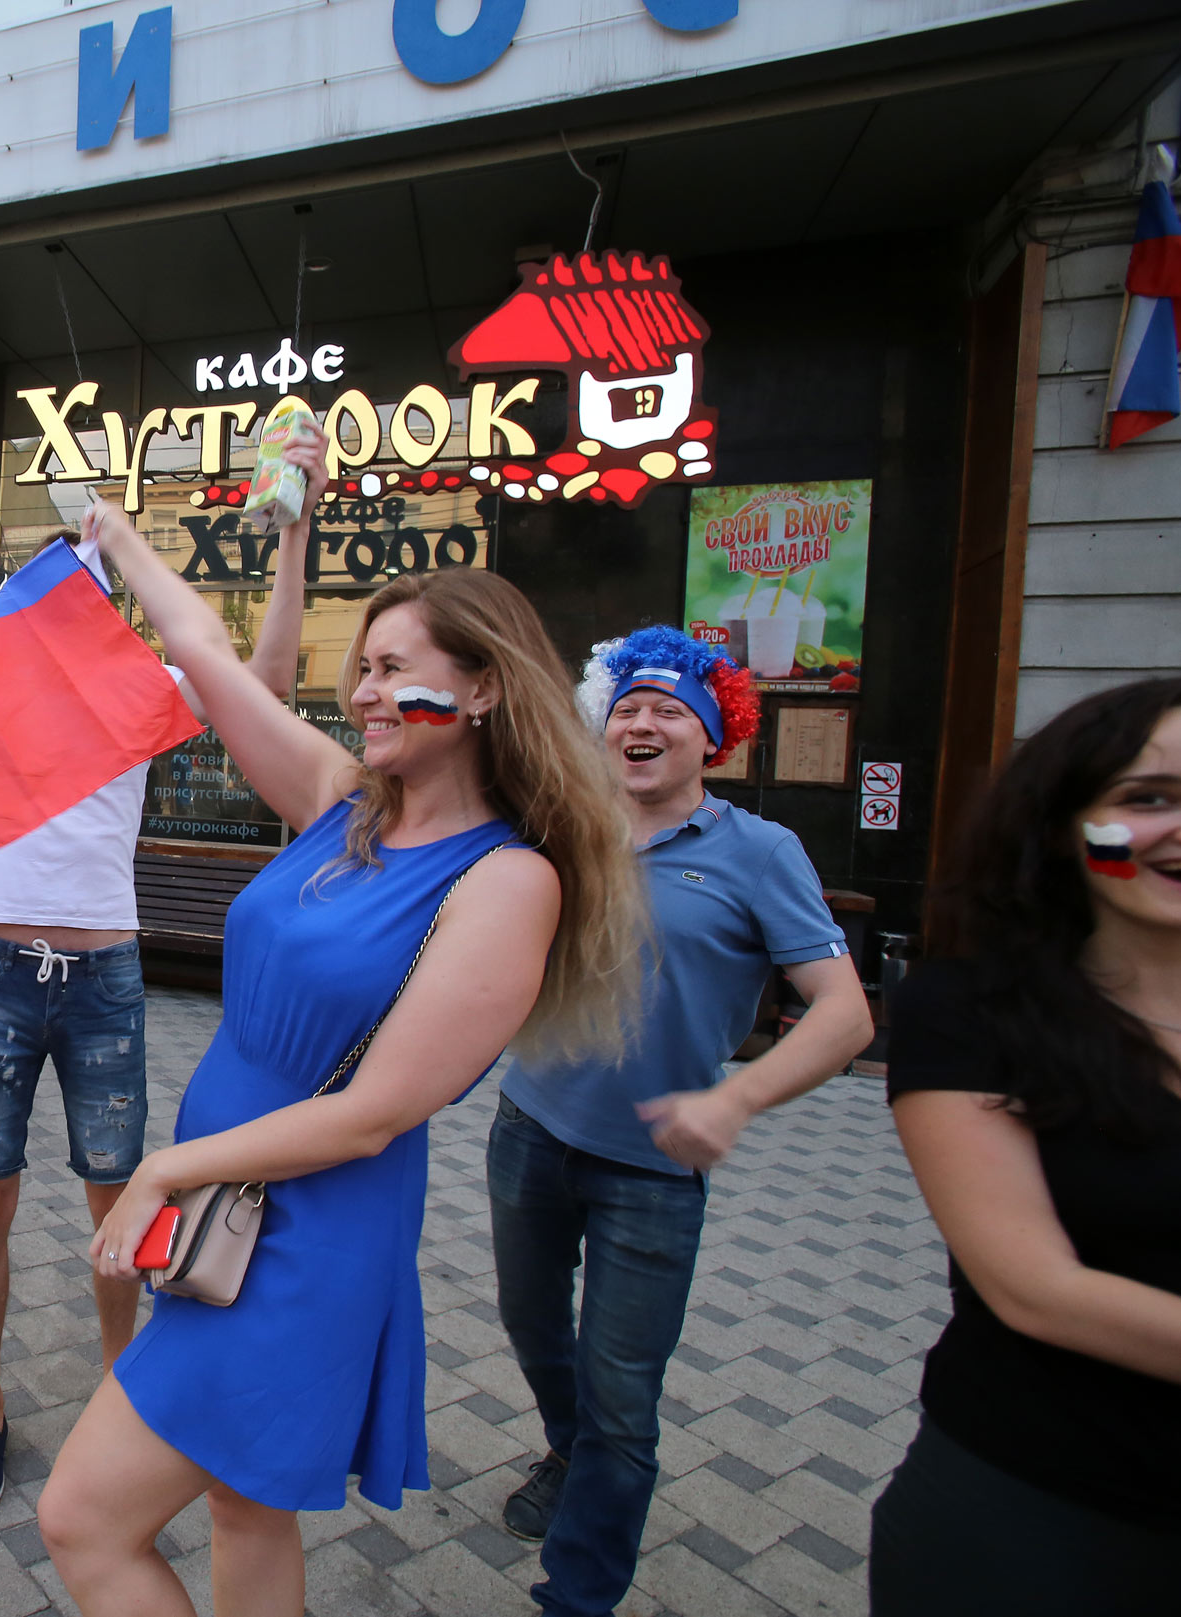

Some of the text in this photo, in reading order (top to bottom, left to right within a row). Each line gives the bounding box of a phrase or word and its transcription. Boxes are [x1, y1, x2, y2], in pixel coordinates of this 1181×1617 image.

[76, 5, 173, 152] И
[195, 337, 345, 395] кафе
[705, 500, 851, 550] СВОЙ ВКУС
[728, 536, 831, 573] ПРОХЛАДЫ
[154, 786, 255, 802] присутствии!
[173, 771, 181, 781] в
[148, 816, 260, 839] #хутороккафе
